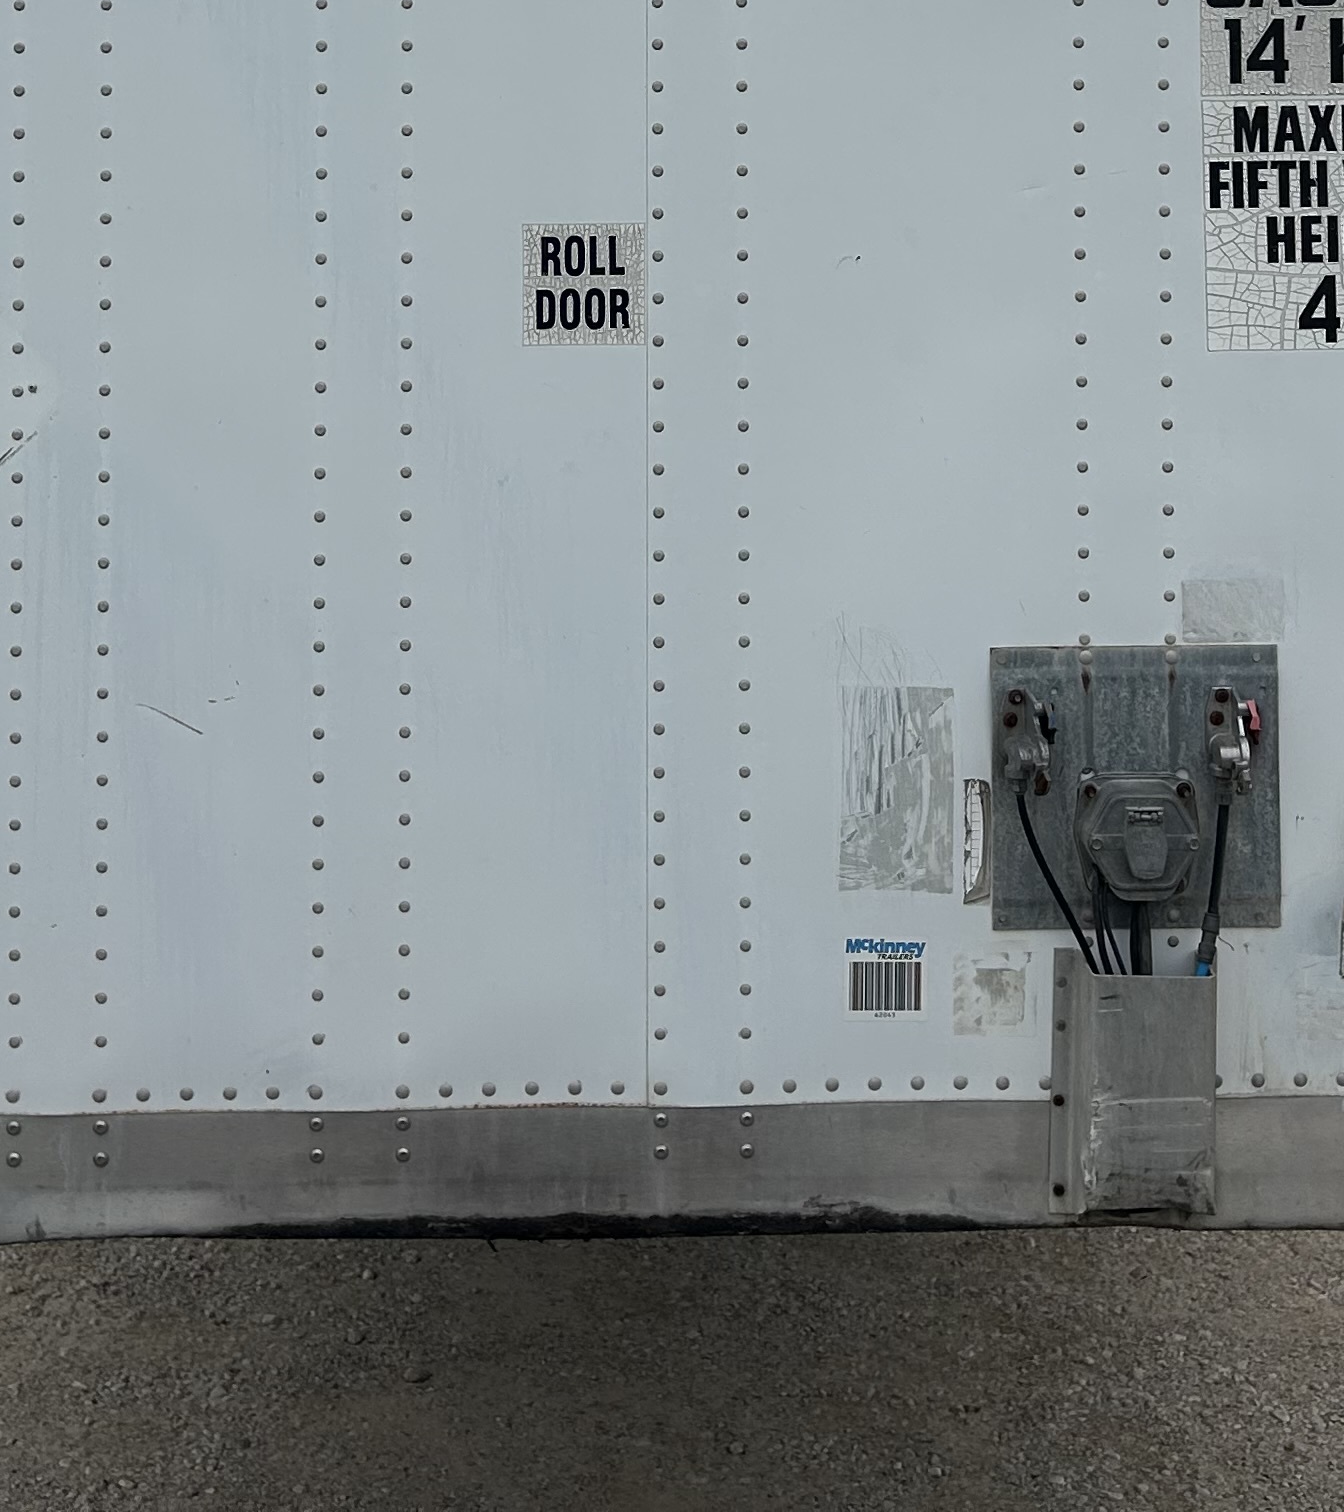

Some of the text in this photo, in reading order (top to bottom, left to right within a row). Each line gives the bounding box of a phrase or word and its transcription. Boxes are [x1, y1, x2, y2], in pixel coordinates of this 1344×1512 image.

[1224, 15, 1306, 84] 14'
[1208, 159, 1329, 209] FIFTH
[541, 235, 626, 277] ROLL
[536, 288, 631, 330] DOOR
